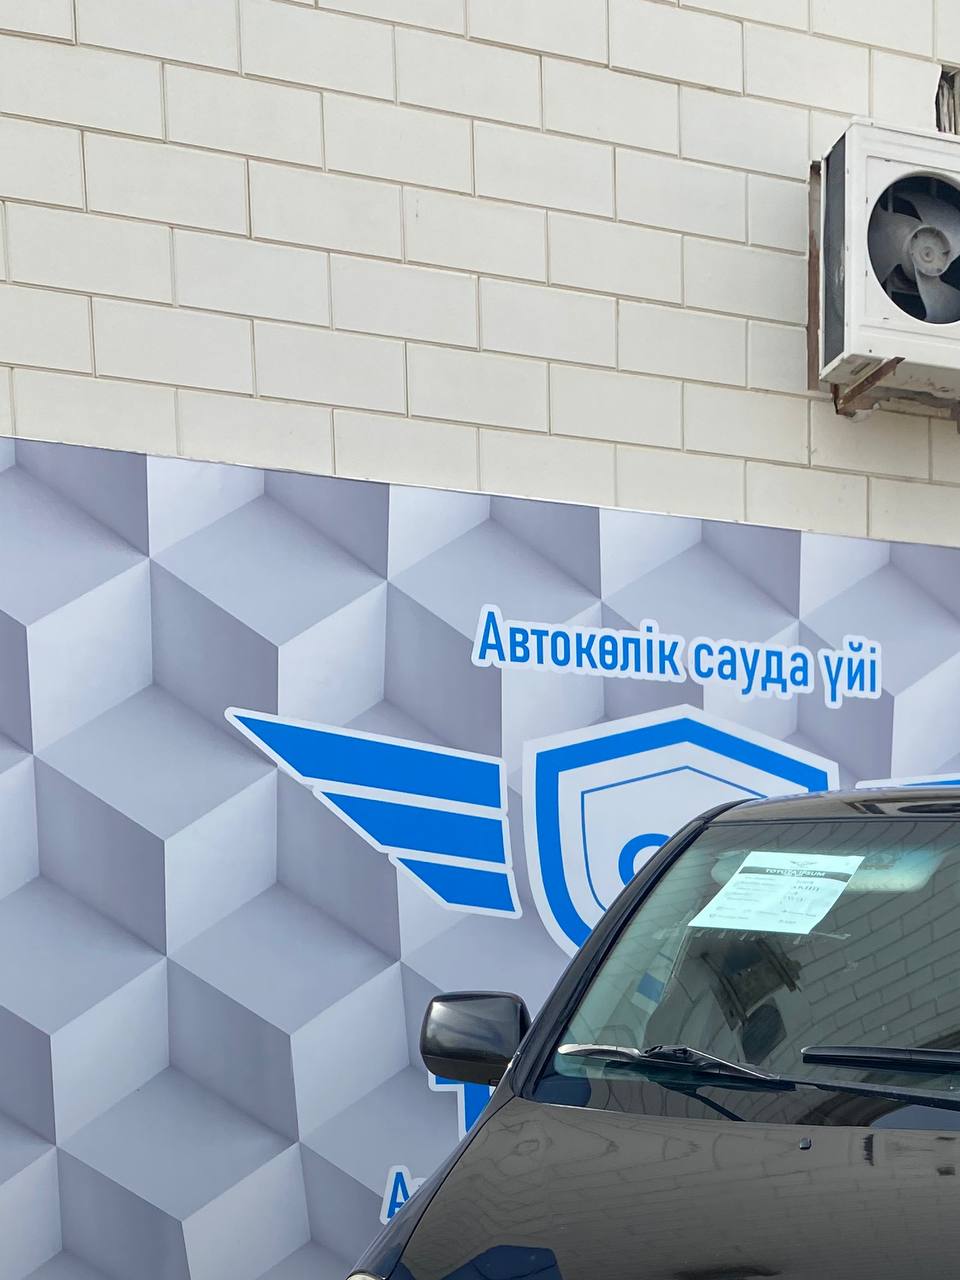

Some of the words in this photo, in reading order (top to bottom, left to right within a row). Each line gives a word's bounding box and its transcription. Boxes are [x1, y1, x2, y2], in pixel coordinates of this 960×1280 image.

[478, 611, 680, 676] Автокөлік
[694, 642, 809, 694] сауда
[824, 641, 877, 702] үйі
